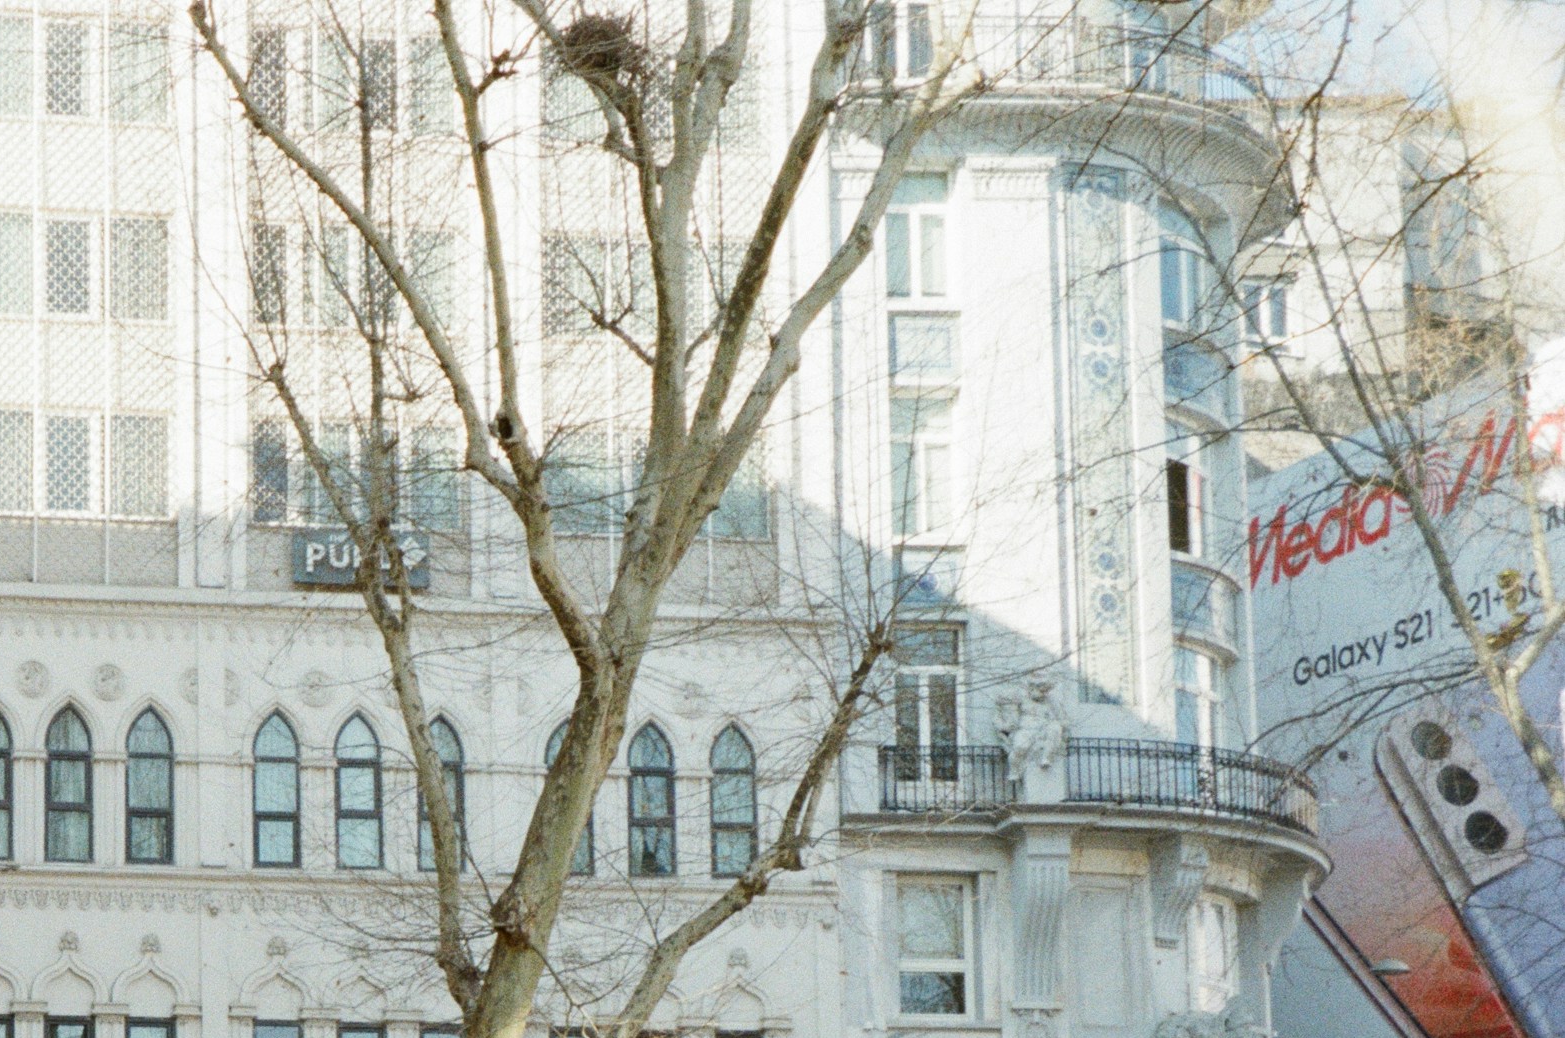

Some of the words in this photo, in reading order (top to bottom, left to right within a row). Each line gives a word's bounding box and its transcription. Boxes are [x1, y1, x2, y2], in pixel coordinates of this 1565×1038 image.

[1292, 630, 1388, 686] Galaxy
[1394, 609, 1433, 650] S21
[1451, 586, 1505, 629] 21+
